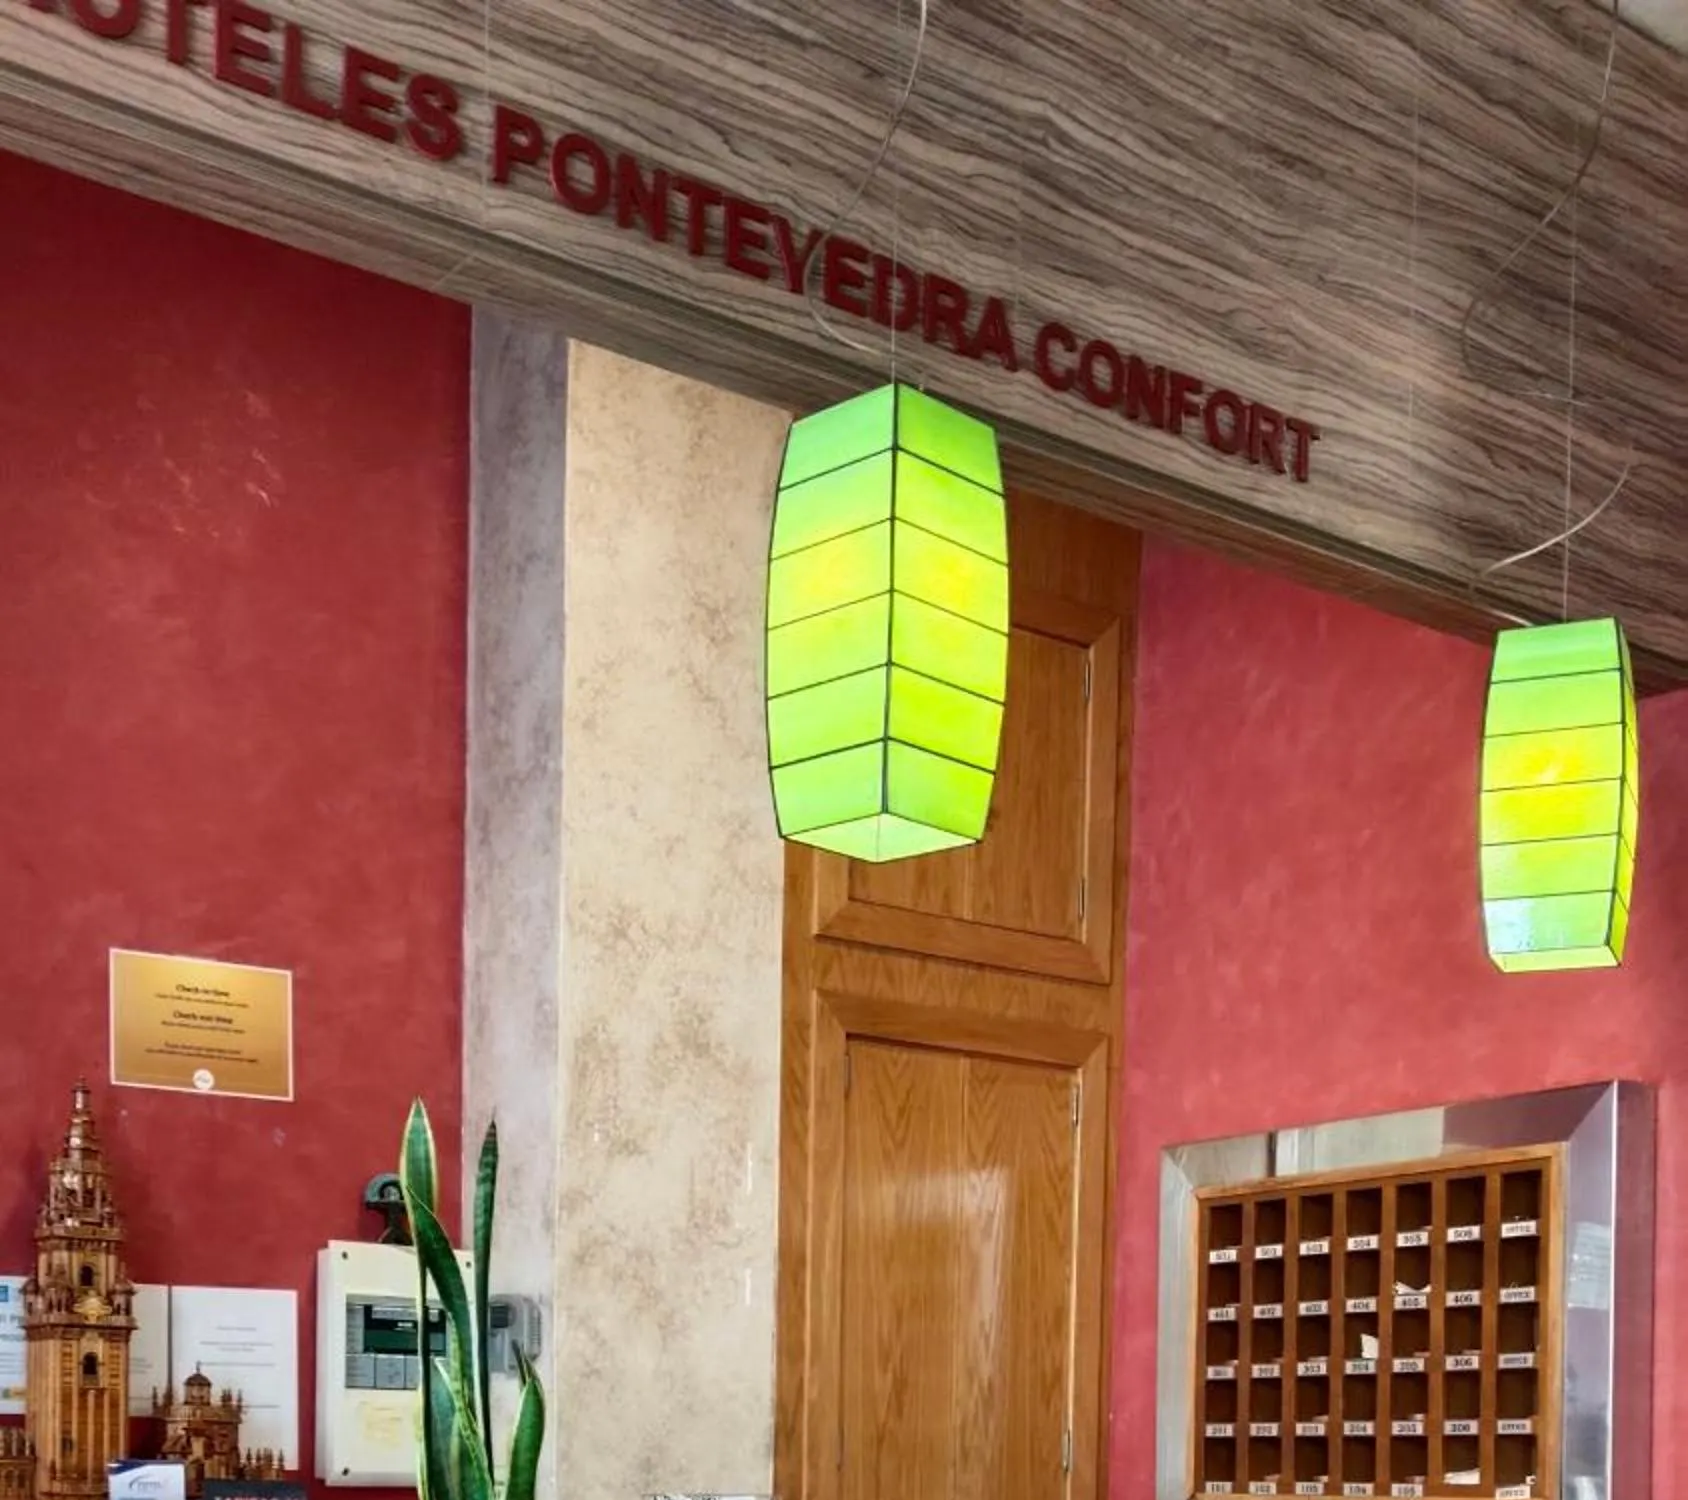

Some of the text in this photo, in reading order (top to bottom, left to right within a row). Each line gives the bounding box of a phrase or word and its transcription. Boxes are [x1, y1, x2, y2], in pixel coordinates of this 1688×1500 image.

[28, 0, 1321, 483] OTELES PONTEVEDRA CONFORT
